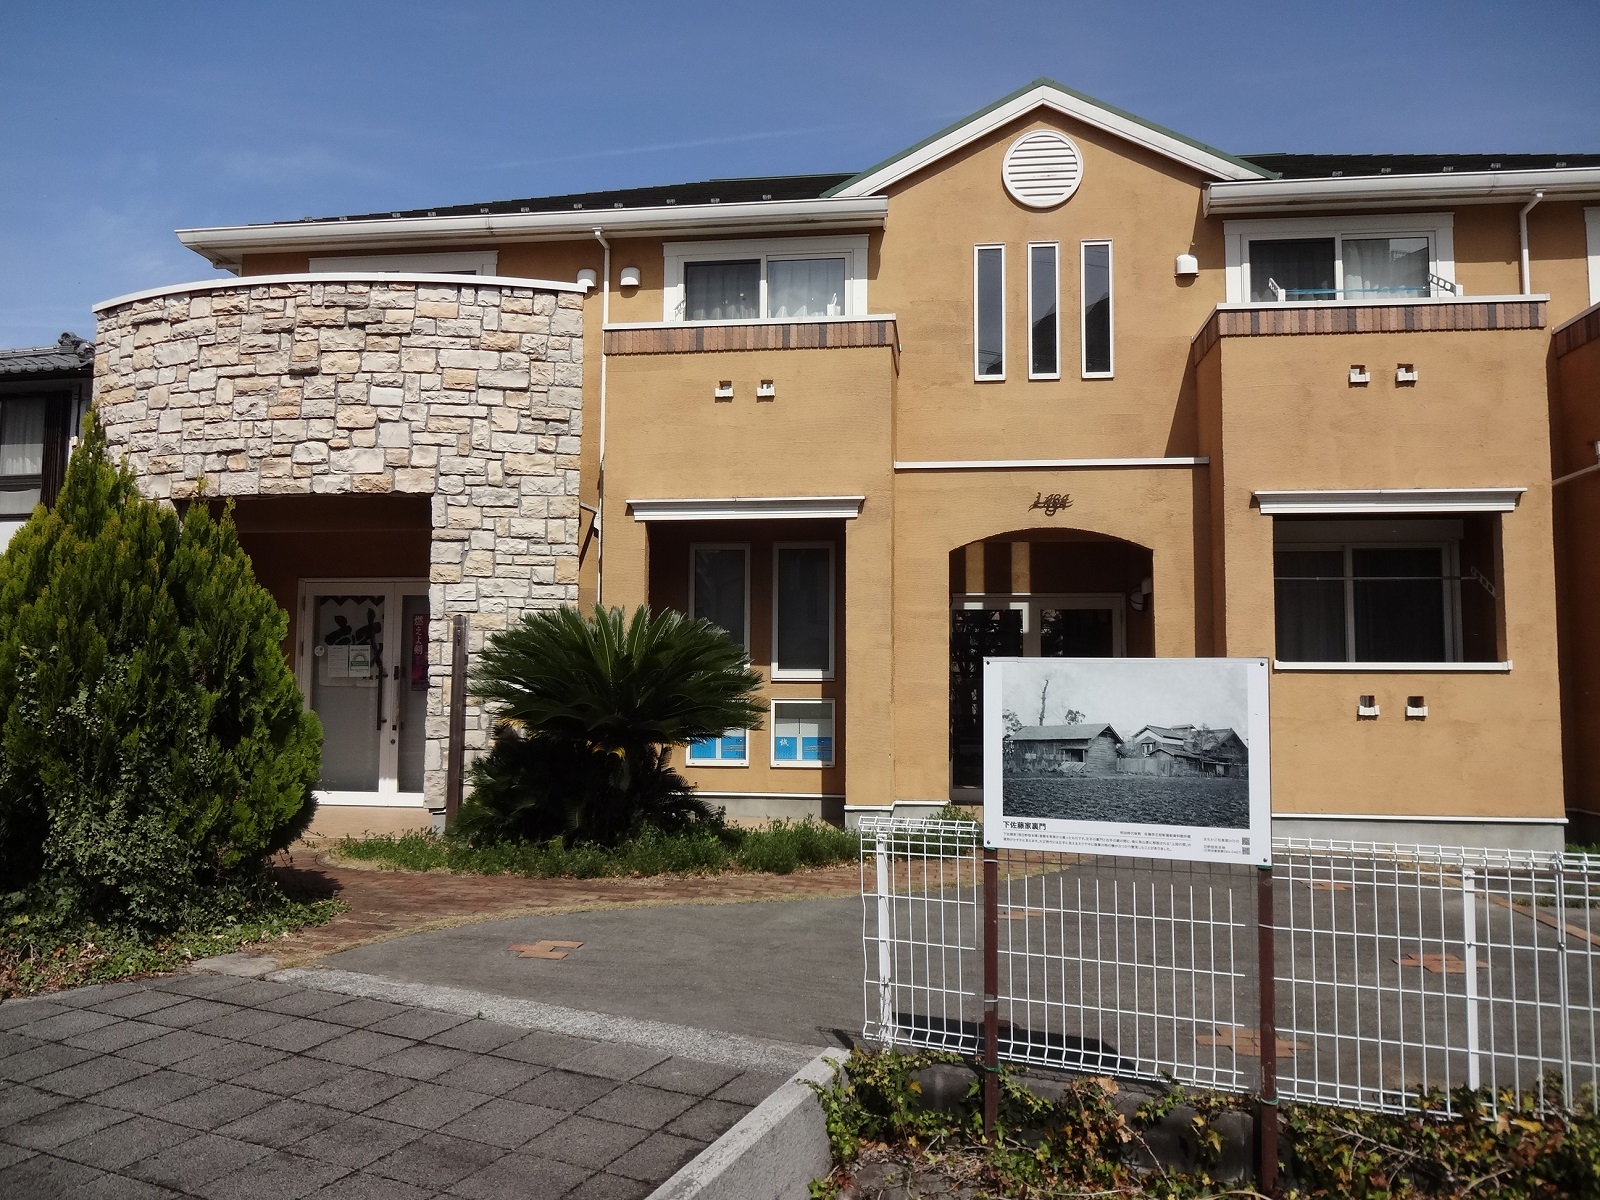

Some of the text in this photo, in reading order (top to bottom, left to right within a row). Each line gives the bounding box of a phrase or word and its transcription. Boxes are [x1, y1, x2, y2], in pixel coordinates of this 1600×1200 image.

[413, 615, 423, 655] 燃えよ剣
[1002, 820, 1047, 831] 下佐藤家裏門
